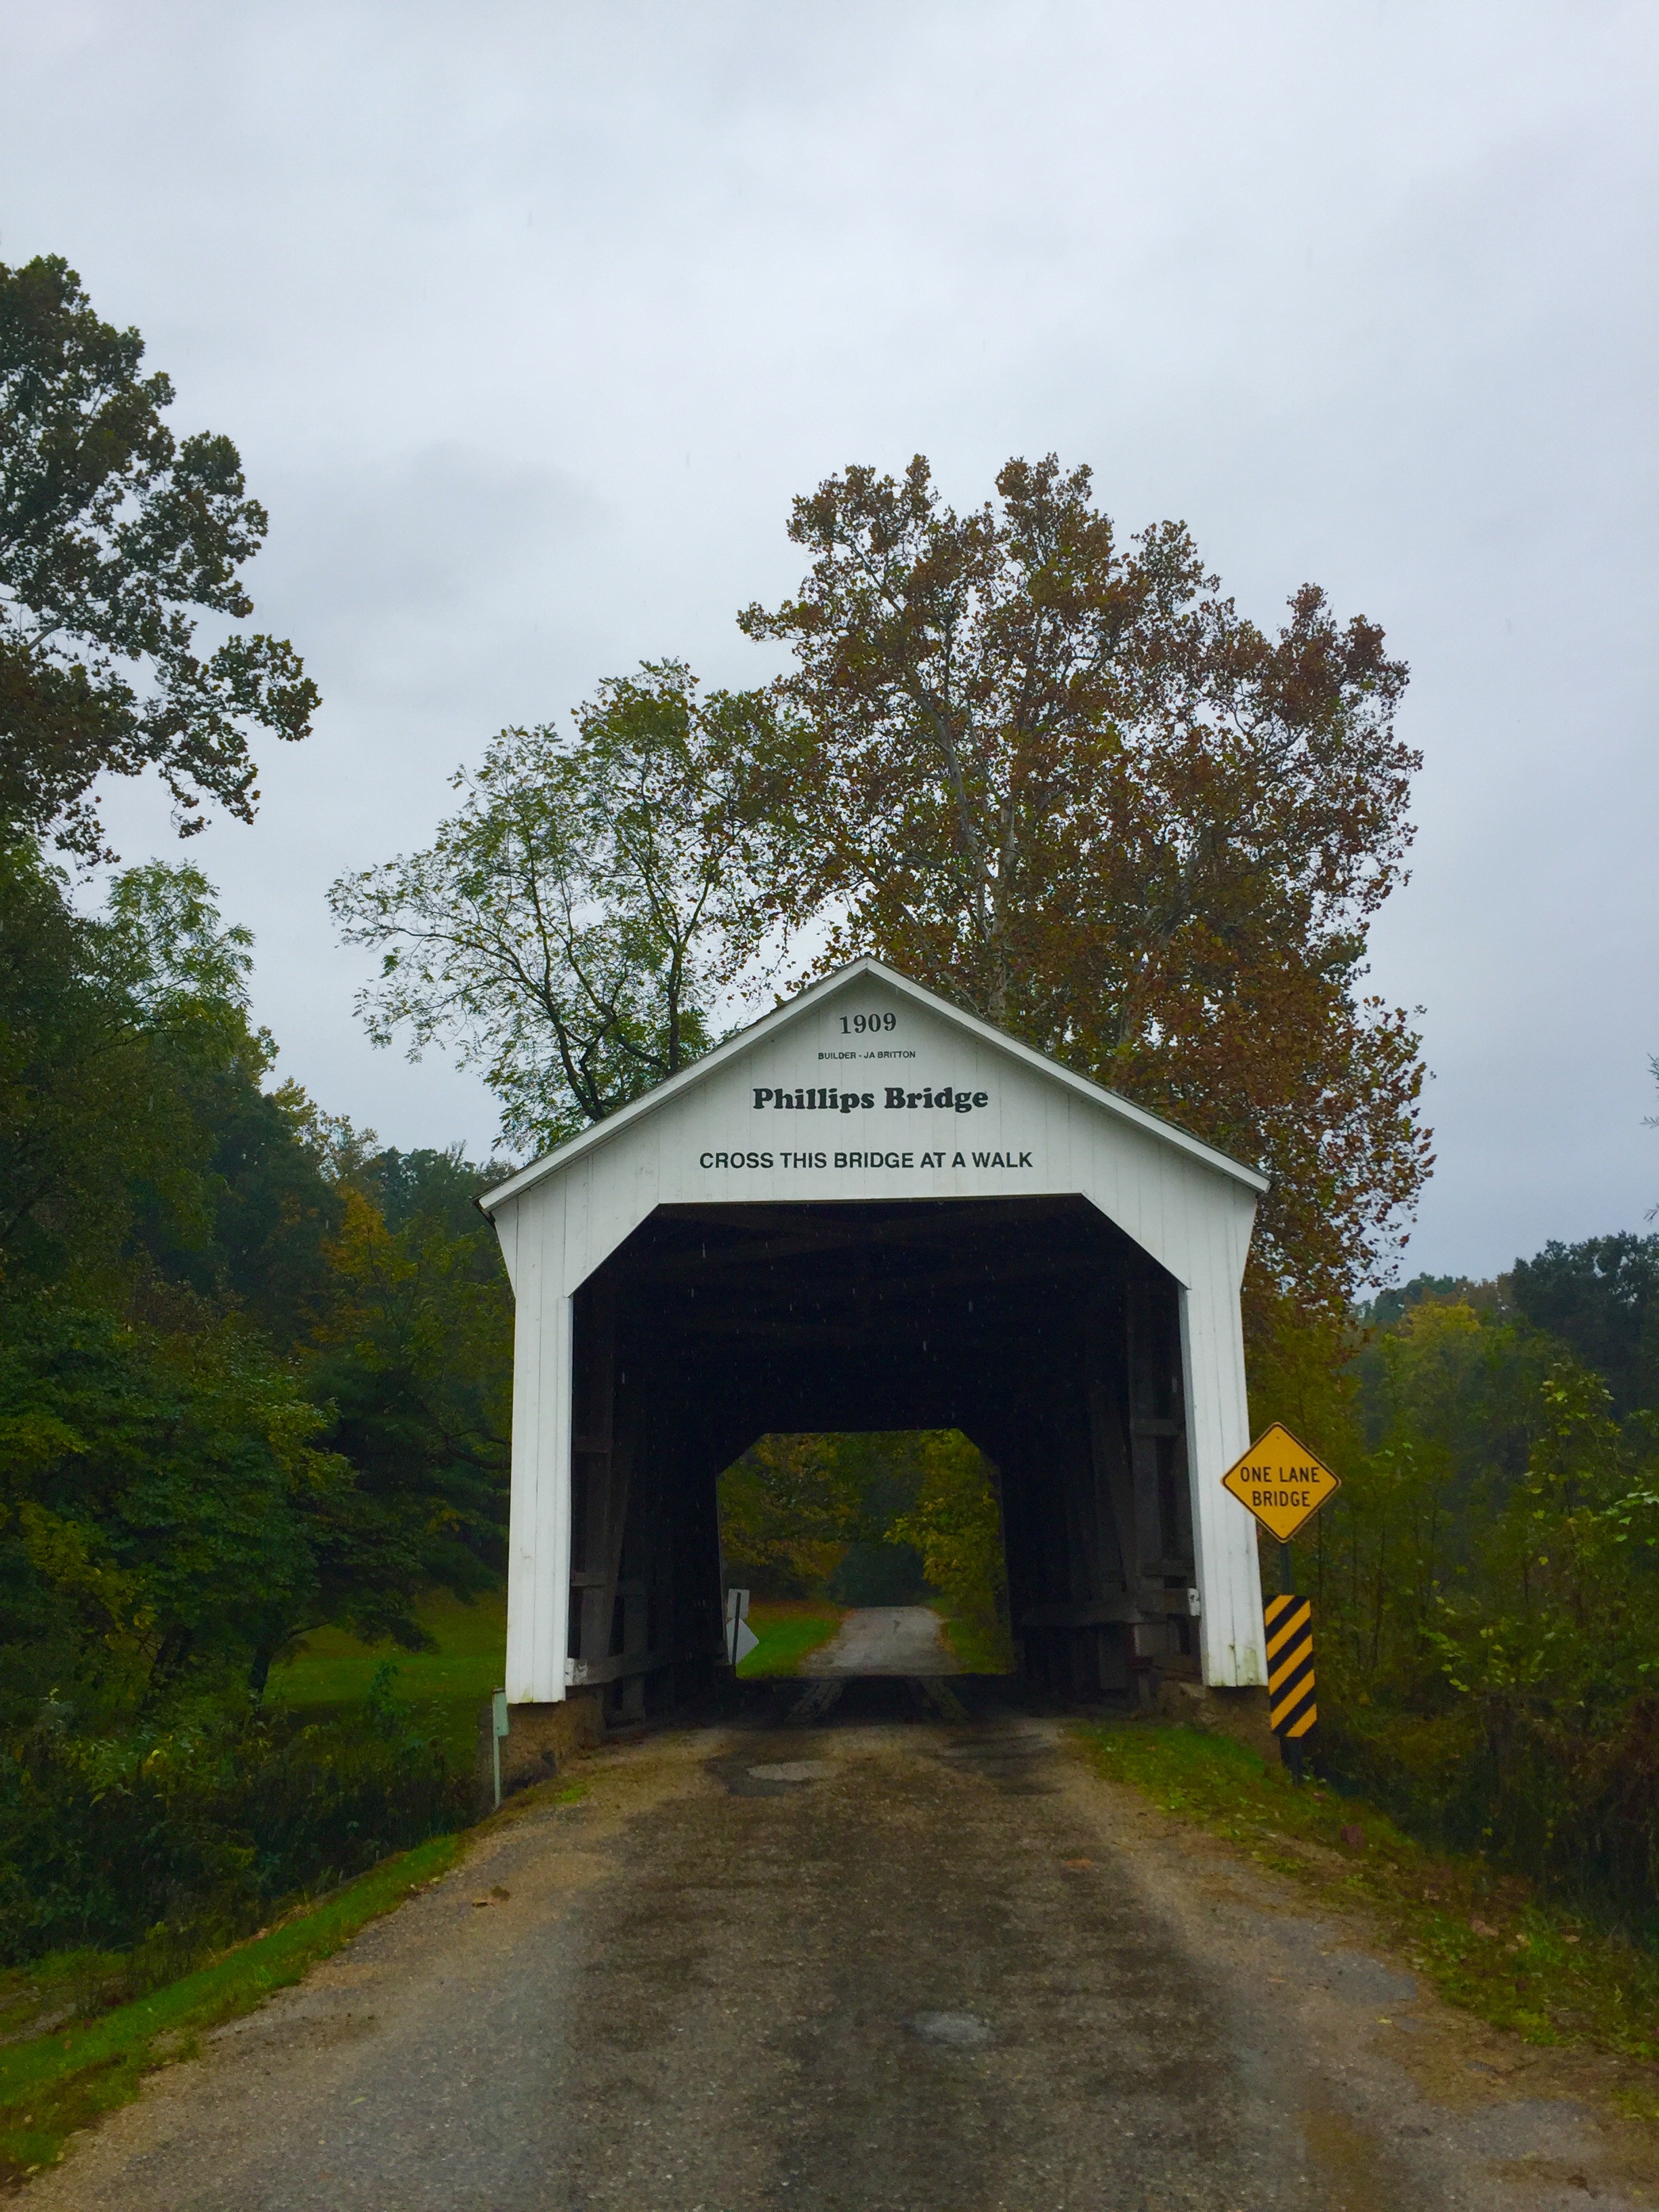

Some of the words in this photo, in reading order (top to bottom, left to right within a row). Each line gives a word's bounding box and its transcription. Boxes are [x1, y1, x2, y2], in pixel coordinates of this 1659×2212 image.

[839, 1012, 897, 1034] 1909
[817, 1052, 857, 1060] BUILDER
[863, 1051, 876, 1059] JA
[877, 1050, 916, 1059] BRITTON
[752, 1088, 875, 1114] Phillips
[884, 1086, 989, 1113] Bridge
[699, 1152, 774, 1169] CROSS
[779, 1152, 827, 1169] THIS
[834, 1151, 914, 1169] BRIDGE
[920, 1151, 947, 1168] AT
[951, 1151, 966, 1168] A
[971, 1151, 1033, 1168] WALK
[1240, 1467, 1272, 1482] ONE
[1279, 1467, 1319, 1482] LANE
[1252, 1491, 1310, 1507] BRIDGE
